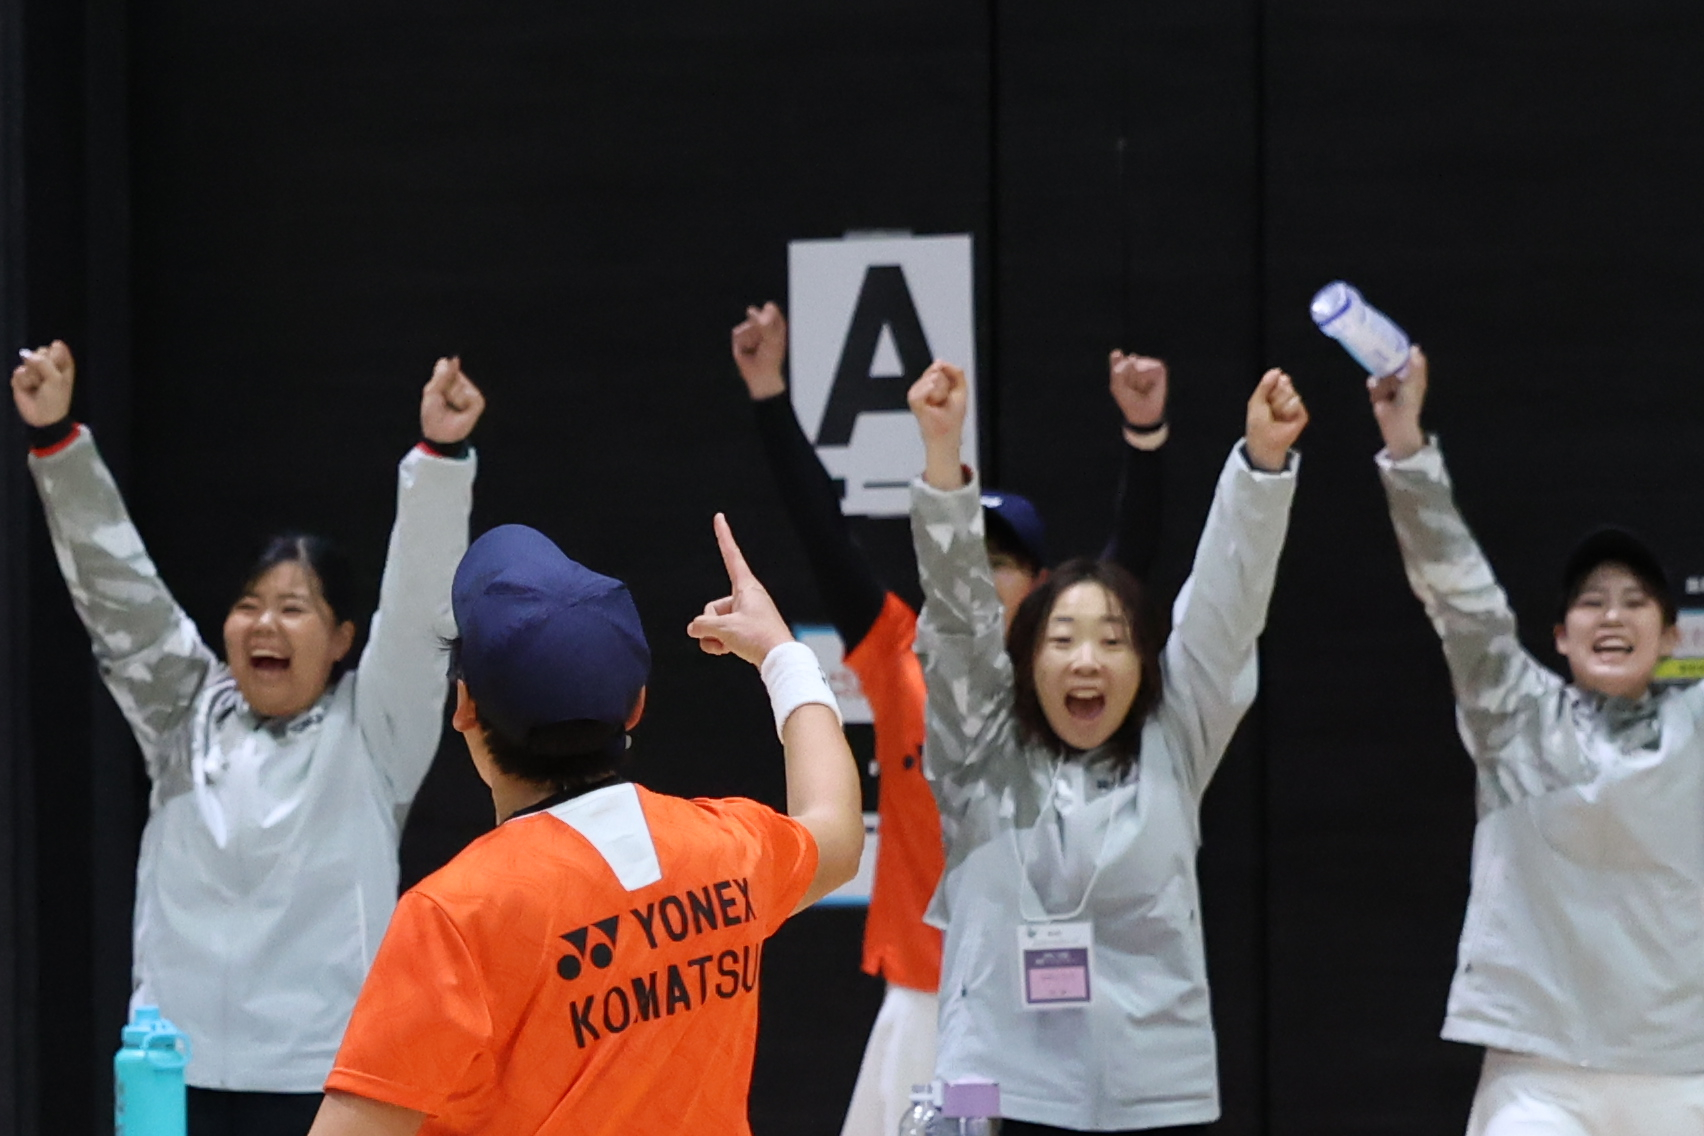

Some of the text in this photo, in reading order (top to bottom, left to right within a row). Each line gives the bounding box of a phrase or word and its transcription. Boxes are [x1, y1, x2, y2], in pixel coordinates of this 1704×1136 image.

[815, 264, 936, 448] A
[629, 877, 758, 950] YONEX
[569, 943, 759, 1049] KOMATSU
